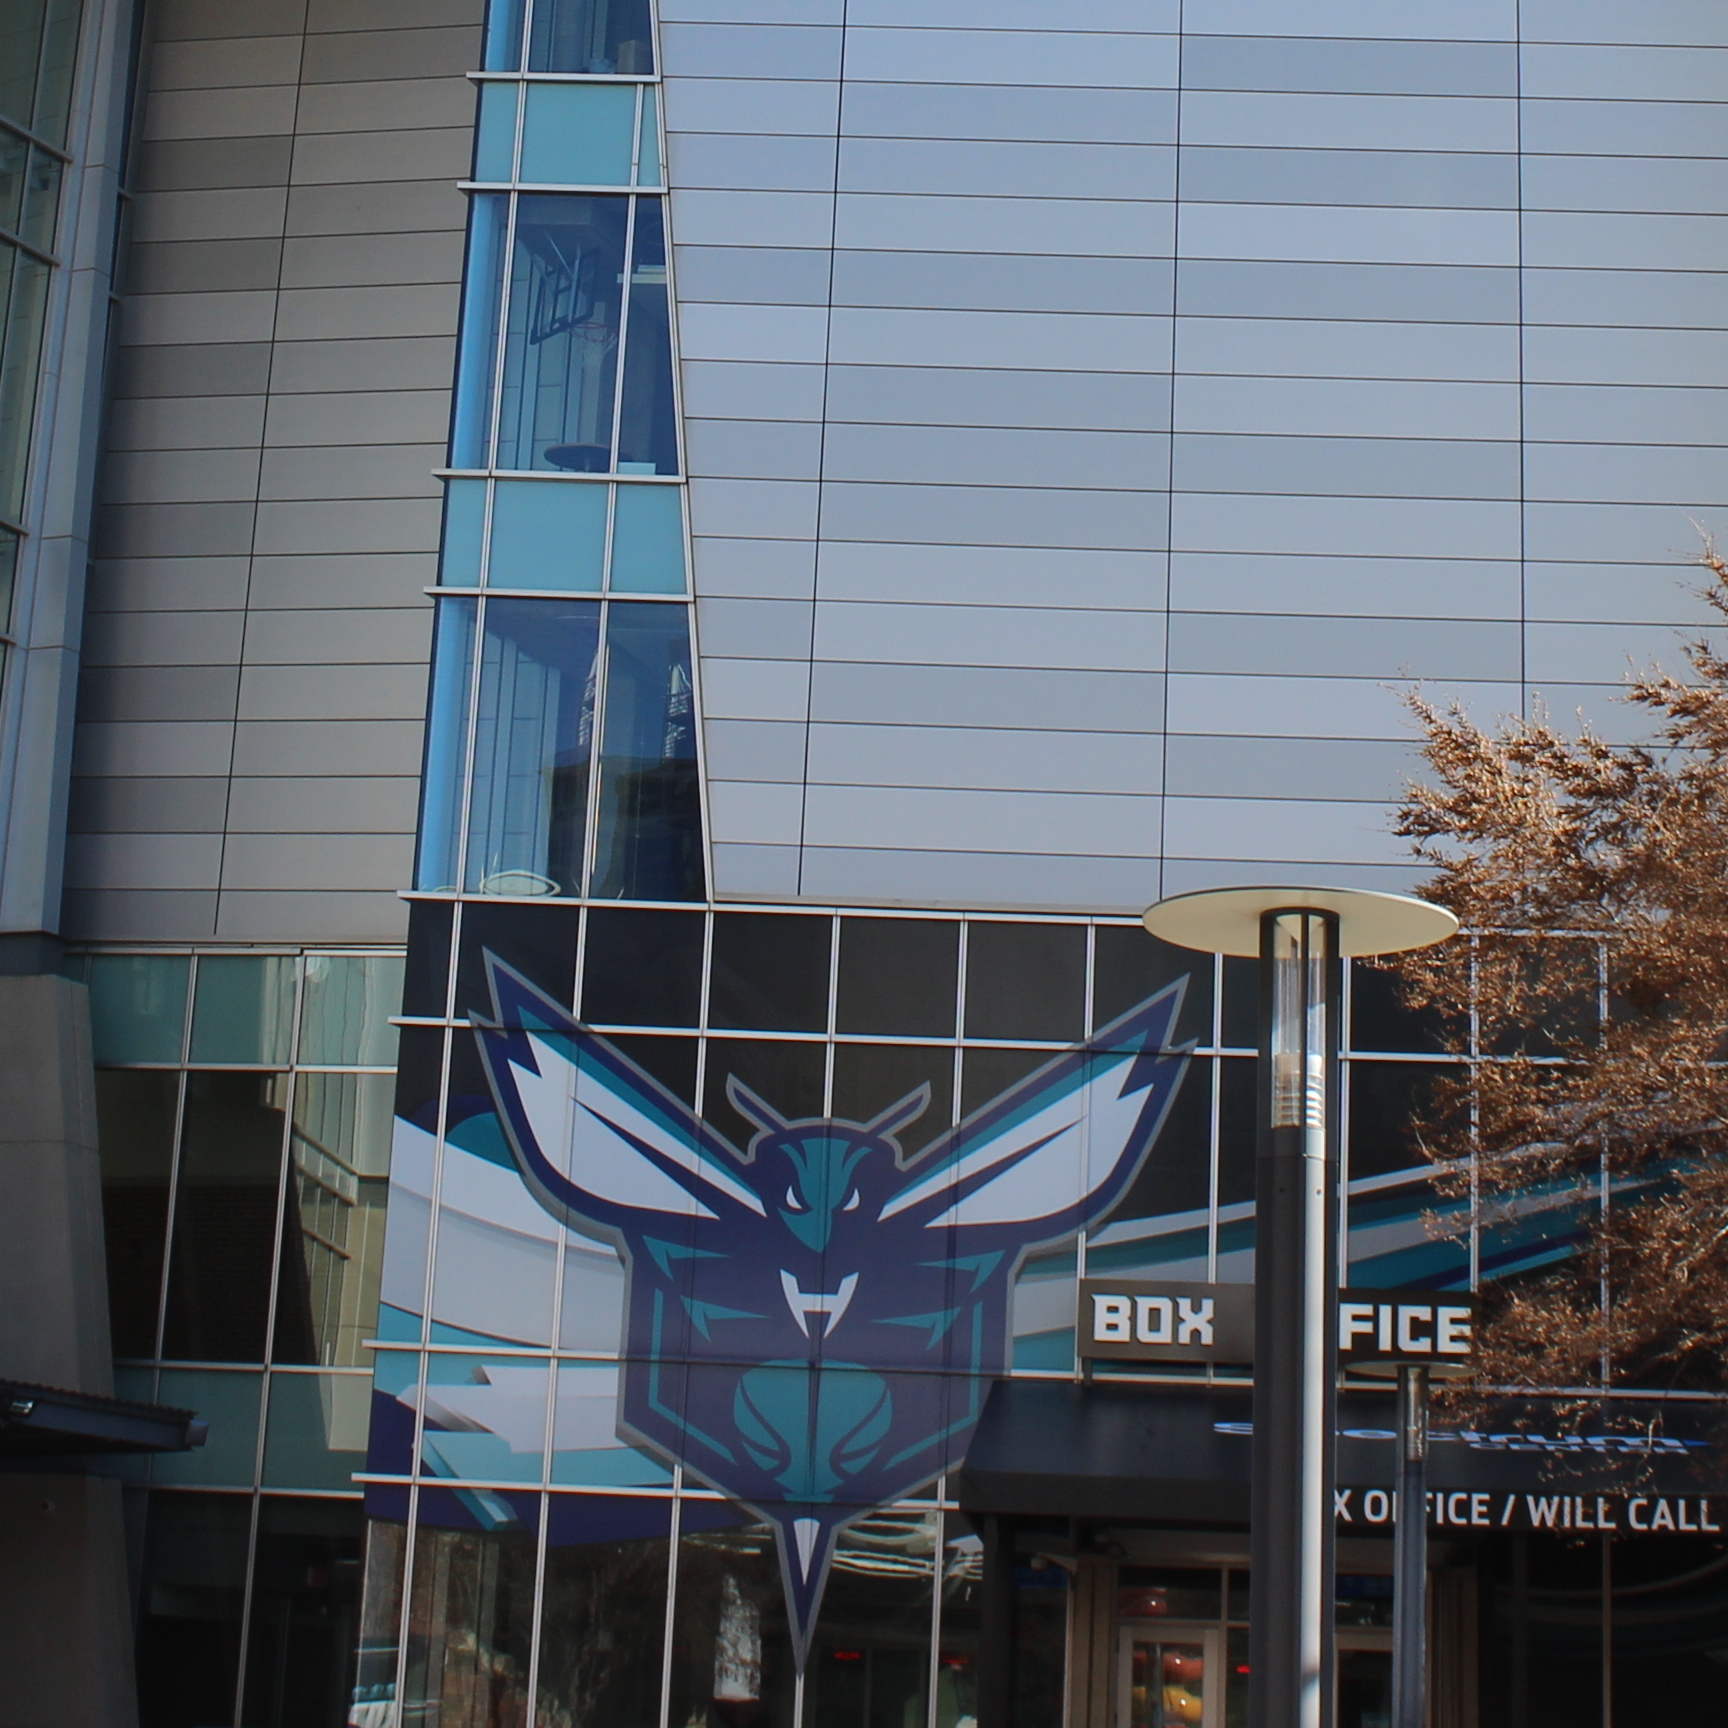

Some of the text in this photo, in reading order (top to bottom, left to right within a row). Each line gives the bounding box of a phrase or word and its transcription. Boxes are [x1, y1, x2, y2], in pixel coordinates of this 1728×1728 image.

[1091, 1294, 1472, 1354] BOX FICE
[1363, 1490, 1490, 1525] OICE
[1526, 1494, 1616, 1530] WILL
[1628, 1497, 1720, 1532] CALL
